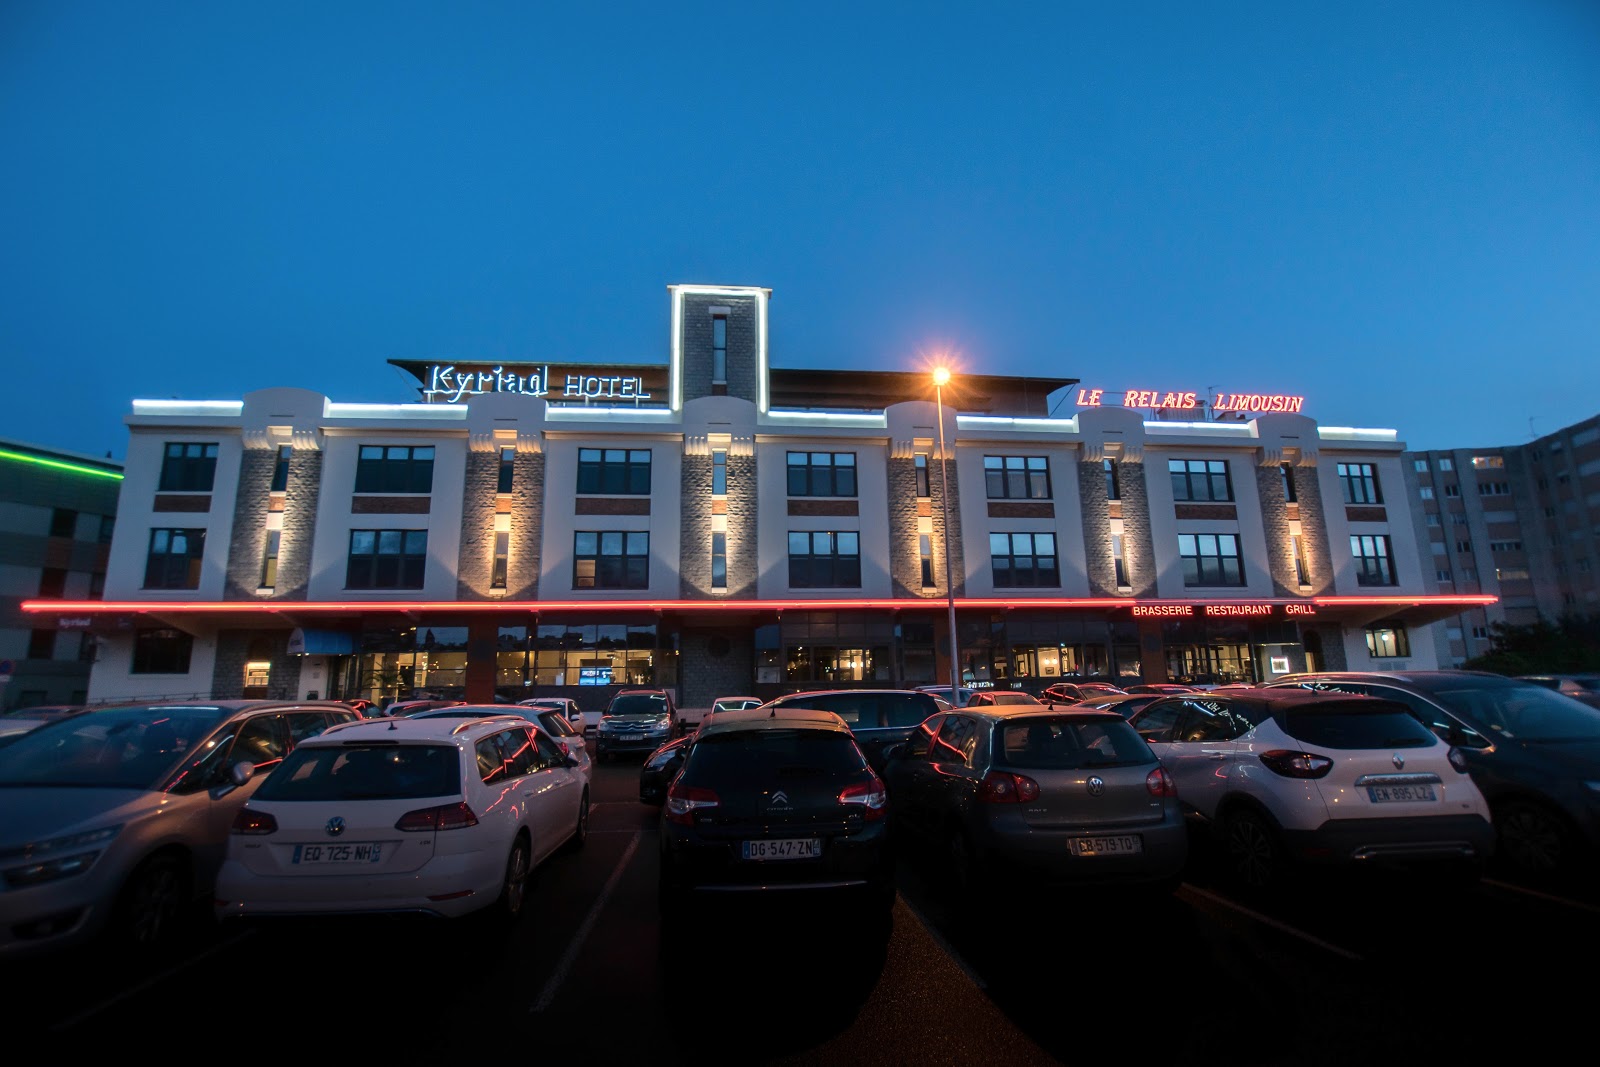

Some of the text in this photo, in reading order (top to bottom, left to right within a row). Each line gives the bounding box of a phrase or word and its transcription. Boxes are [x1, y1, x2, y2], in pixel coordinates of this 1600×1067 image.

[428, 365, 650, 403] Kyriad HOTEL
[1077, 388, 1304, 413] LE RELAIS LIMOUSIN
[1133, 604, 1316, 616] BRASSERIE RESTAURANT GRILL
[751, 840, 813, 857] DG-547-ZN
